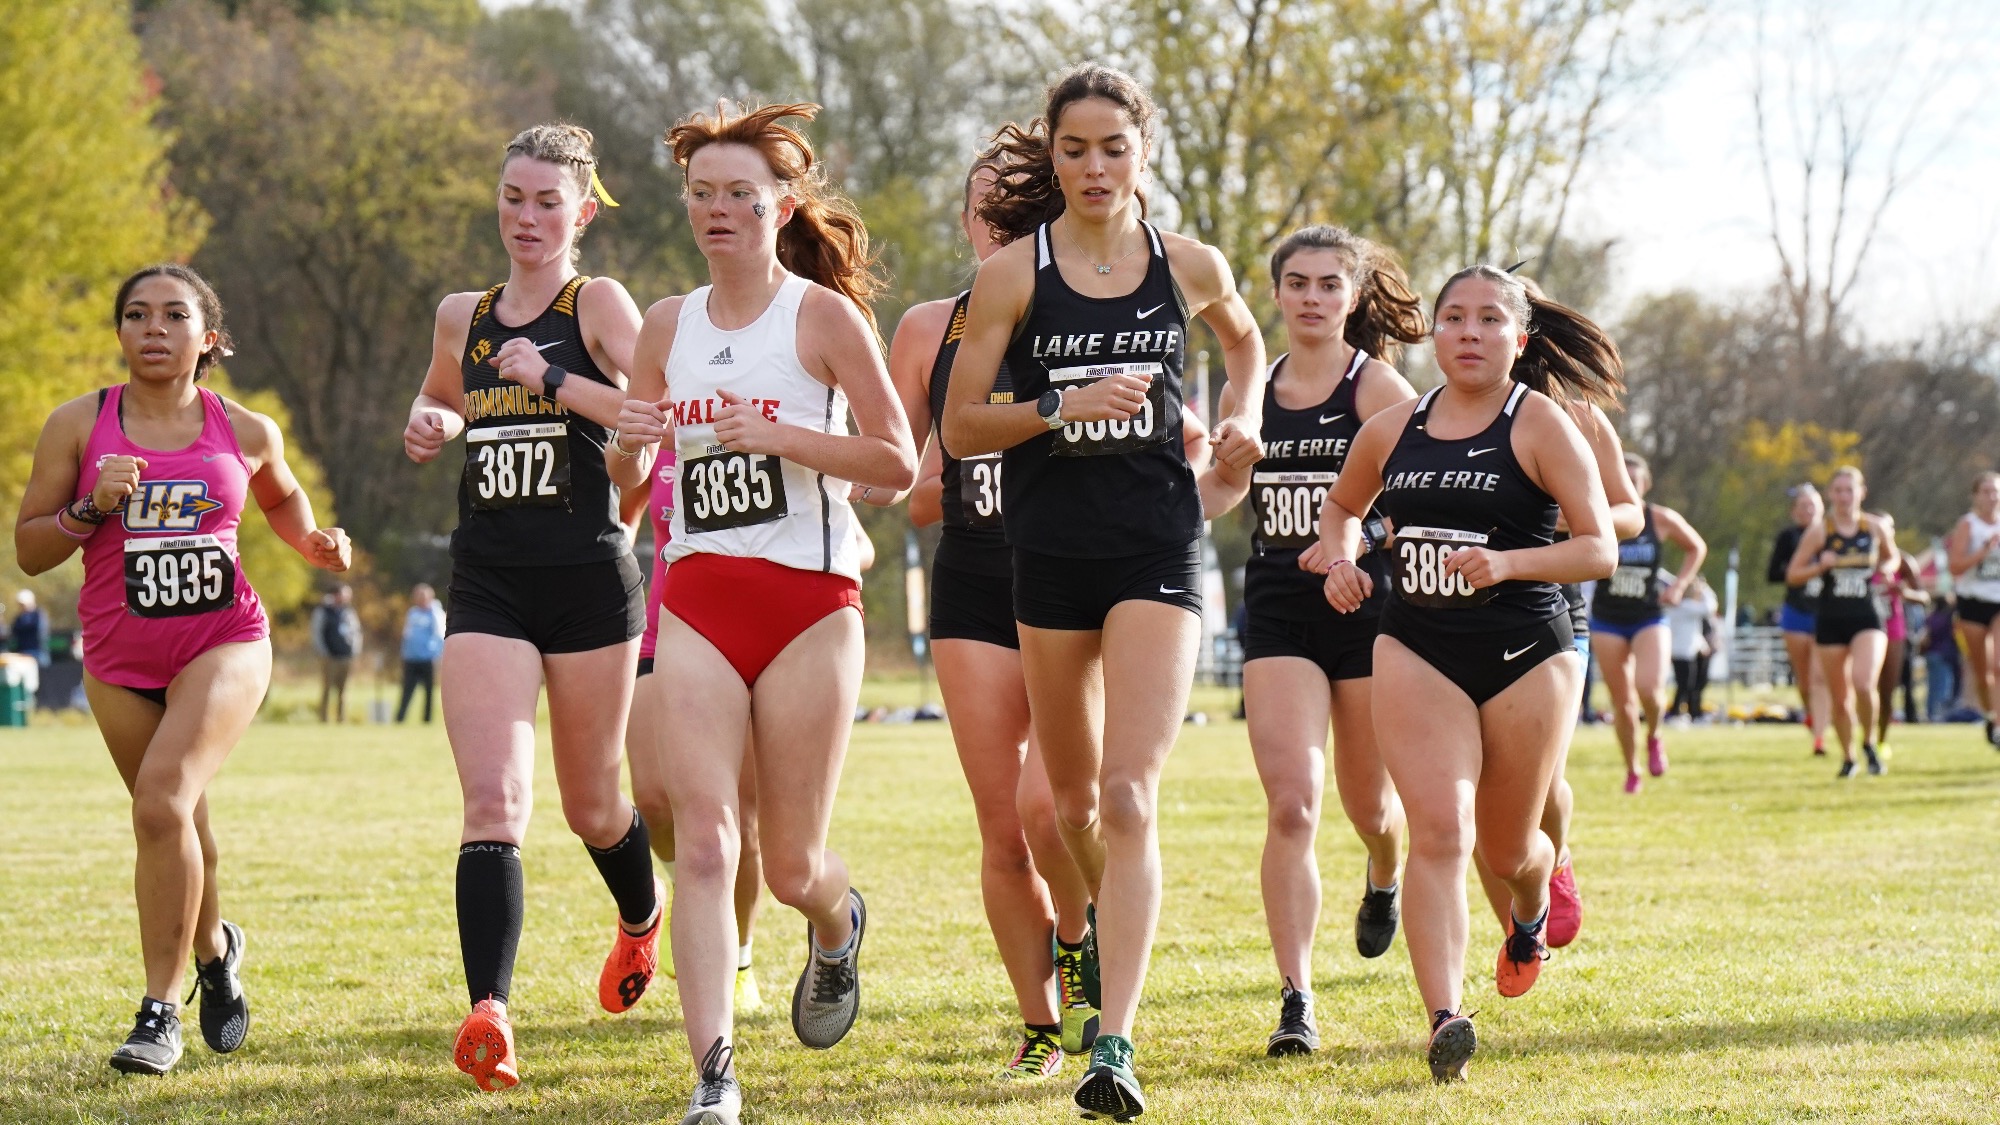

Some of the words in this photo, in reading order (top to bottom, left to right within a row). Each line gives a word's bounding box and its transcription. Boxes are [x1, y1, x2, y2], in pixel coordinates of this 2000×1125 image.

[1032, 333, 1105, 358] LAKE
[1112, 330, 1179, 354] ERIE
[708, 357, 734, 366] adidas
[990, 391, 1014, 404] OHIO
[673, 398, 781, 428] MALE
[1298, 438, 1348, 458] ERIE
[477, 440, 558, 499] 3872
[1385, 471, 1437, 492] LAKE
[1439, 470, 1501, 492] ERIE
[690, 452, 773, 520] 3835
[126, 484, 204, 528] UC
[1262, 486, 1328, 537] 3803
[135, 550, 223, 608] 3935
